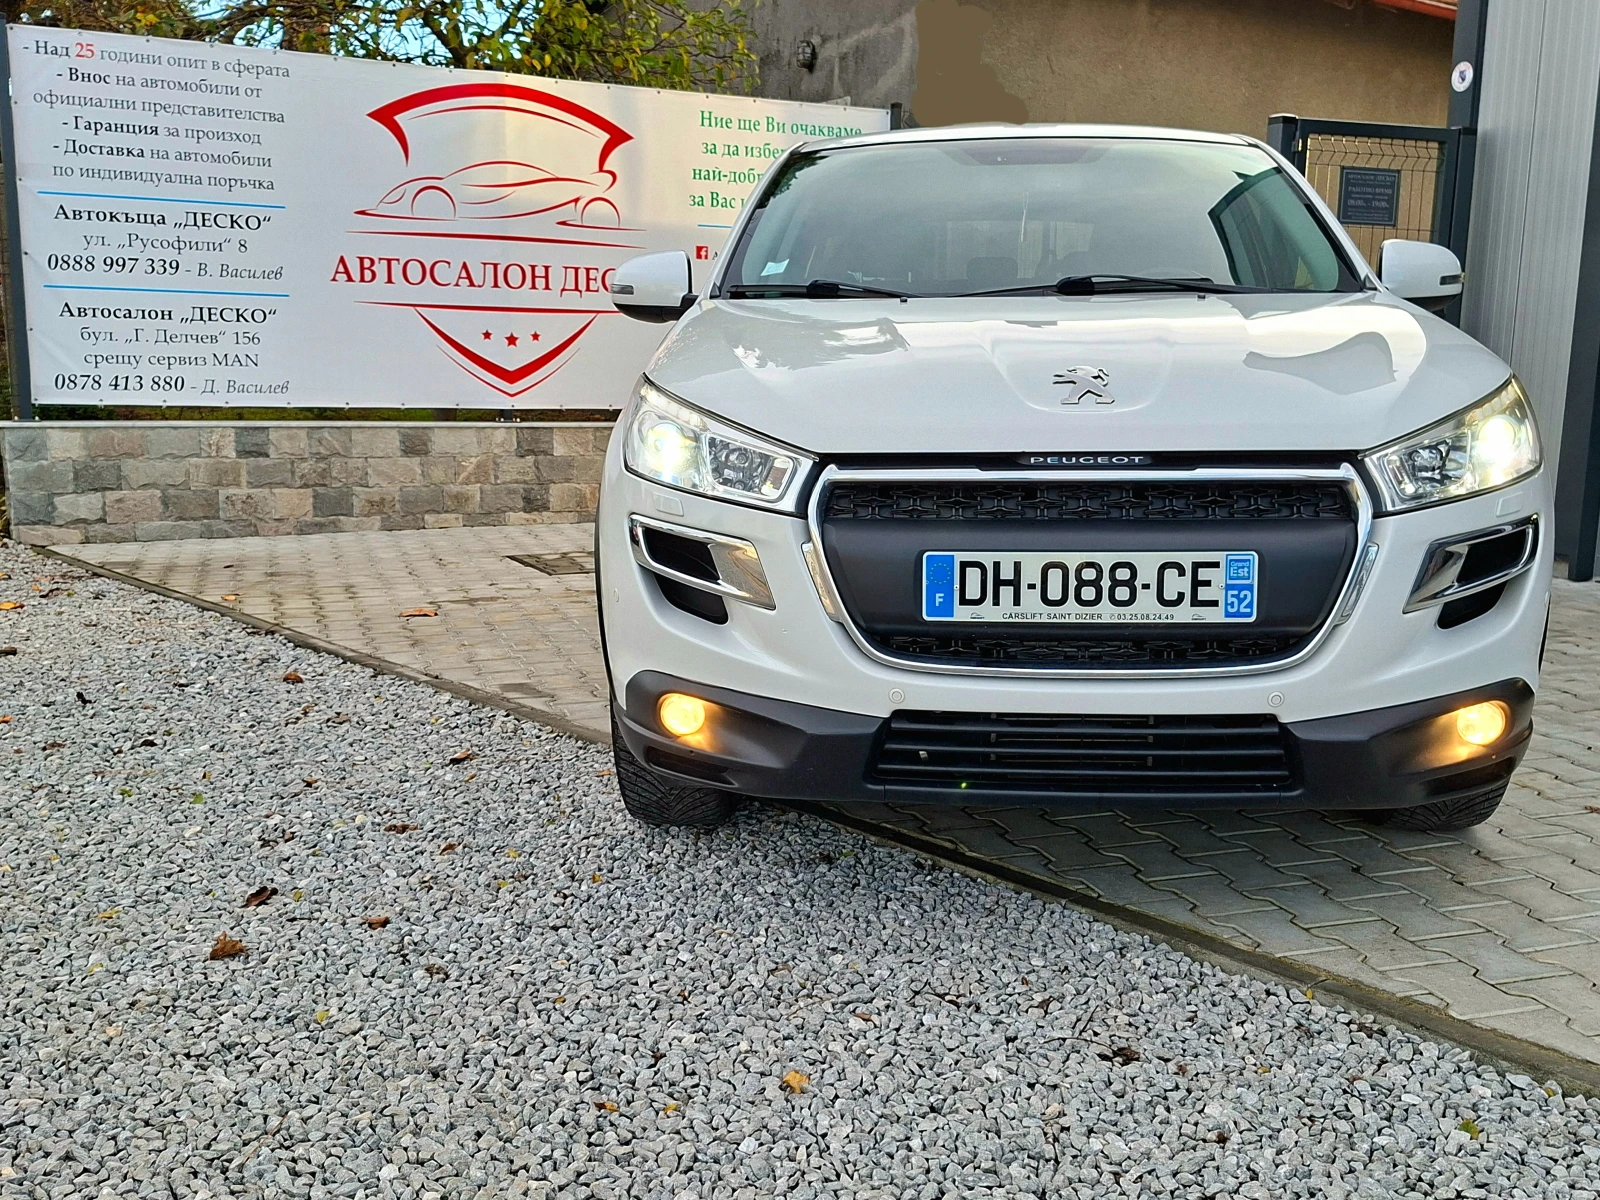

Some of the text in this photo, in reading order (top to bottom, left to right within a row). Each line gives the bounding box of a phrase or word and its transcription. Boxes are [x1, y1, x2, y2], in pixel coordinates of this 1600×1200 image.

[34, 40, 70, 59] Над
[75, 42, 94, 58] 25
[100, 50, 162, 65] години
[167, 57, 207, 69] опит
[212, 61, 220, 70] в
[224, 59, 290, 79] сферата
[68, 67, 110, 84] Внос
[116, 76, 136, 86] на
[141, 78, 240, 96] автомобили
[245, 88, 262, 98] от
[33, 89, 284, 123] официални представителства
[73, 116, 159, 136] Гаранция
[164, 127, 180, 137] за
[185, 129, 261, 146] произход
[700, 110, 732, 129] Ние
[738, 119, 760, 133] ще
[766, 116, 786, 133] Ви
[64, 139, 145, 158] Доставка
[150, 149, 170, 160] на
[175, 151, 272, 167] автомобили
[702, 142, 717, 154] за
[721, 144, 739, 158] да
[53, 166, 274, 192] по индивидуална поръчка
[689, 195, 704, 207] за
[710, 191, 735, 208] Вас
[53, 204, 271, 230] Автокъща „ДЕСКО“
[83, 233, 247, 255] ул. „Русофили“ 8
[48, 254, 95, 272] 0888
[103, 256, 139, 273] 997
[145, 258, 179, 275] 339
[197, 263, 212, 277] В.
[219, 264, 283, 280] Василев
[330, 255, 616, 299] АВТОСАЛОН ДЕС
[59, 302, 276, 325] Автосалон „ДЕСКО“
[80, 327, 260, 346] бул. „Г. Делчев“ 156
[84, 353, 258, 370] срещу сервиз MAN
[55, 374, 101, 390] 0878
[108, 375, 143, 391] 413
[151, 375, 184, 391] 880
[200, 379, 219, 395] Д.
[226, 380, 289, 394] Василев
[1030, 456, 1144, 464] PEUGEOT
[1230, 566, 1249, 577] Est
[958, 560, 1221, 608] DH-088-CE
[935, 593, 944, 606] F
[1227, 590, 1252, 613] 52
[1116, 613, 1175, 621] 03.25.08.24.49
